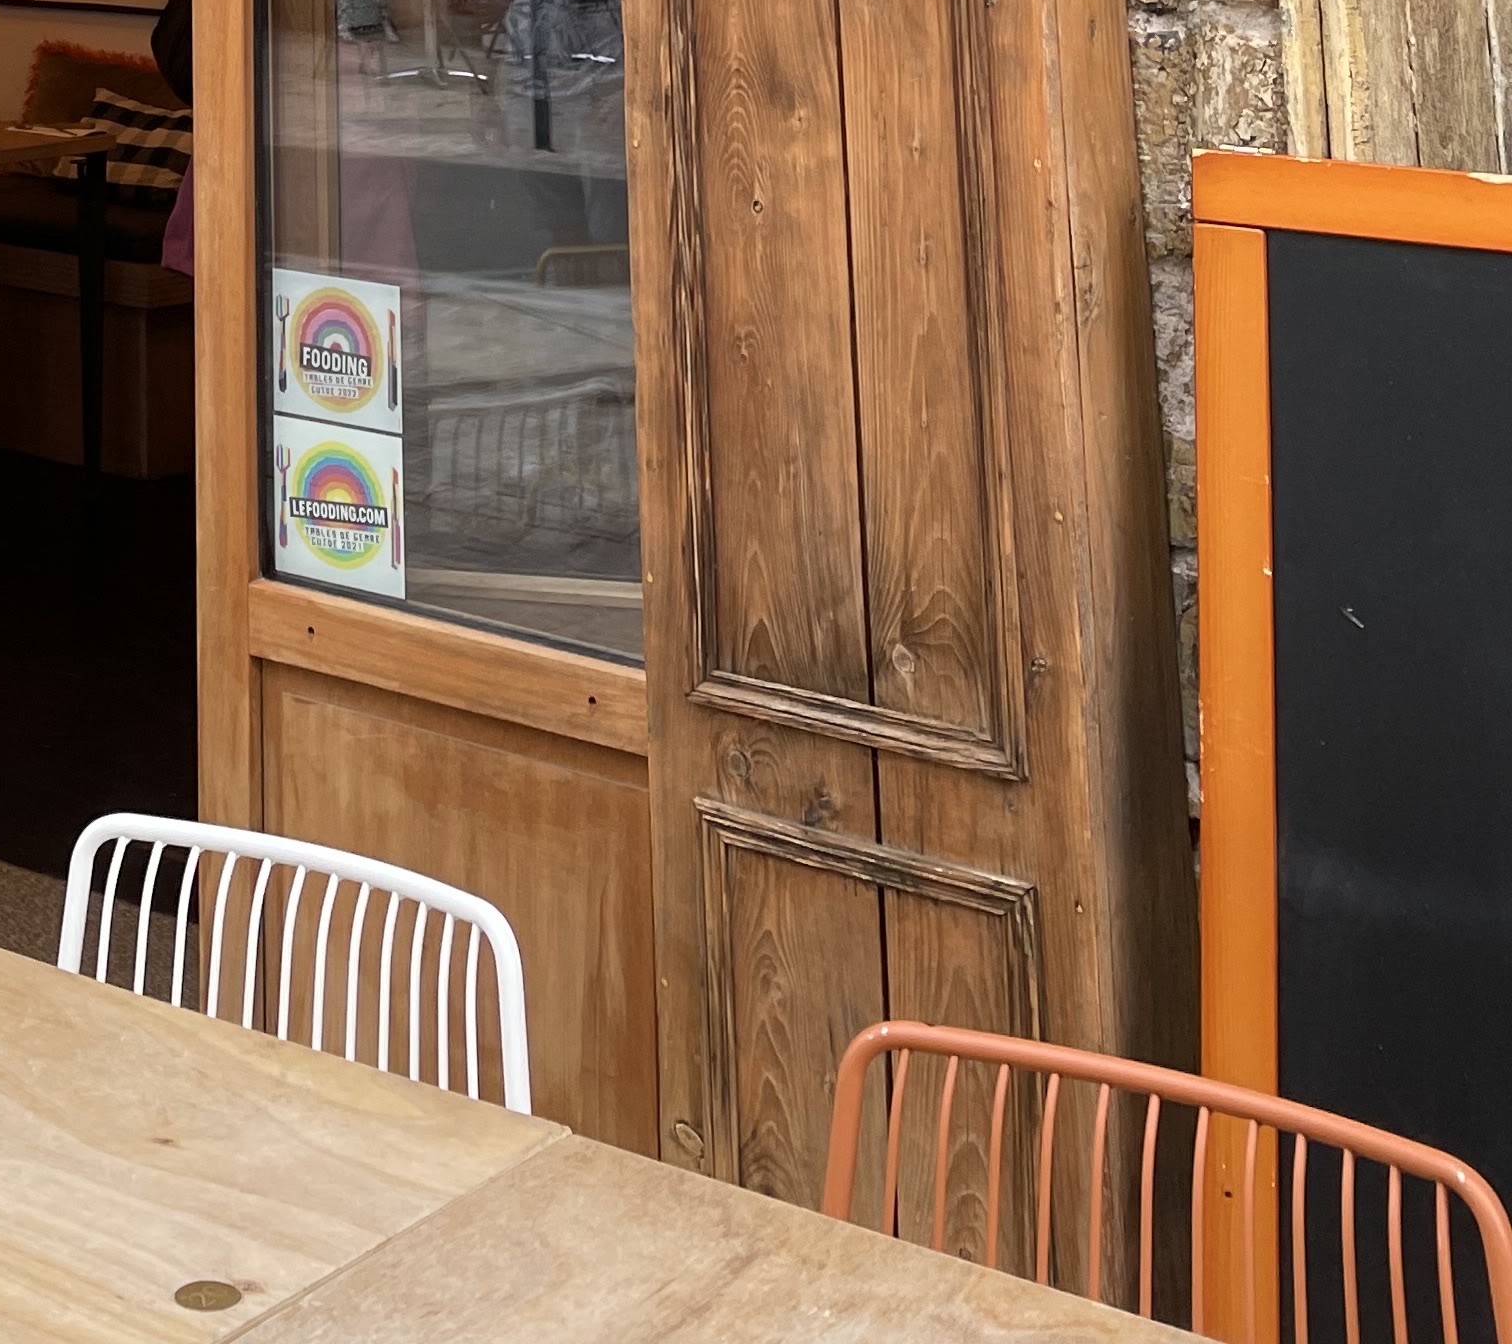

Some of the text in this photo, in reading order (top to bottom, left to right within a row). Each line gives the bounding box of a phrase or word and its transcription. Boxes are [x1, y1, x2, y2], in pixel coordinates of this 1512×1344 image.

[303, 347, 368, 376] FOODING
[304, 373, 333, 384] TABLES
[336, 376, 345, 384] DE
[311, 385, 334, 396] GUIDE
[292, 499, 386, 527] LEFOODING.COM
[305, 526, 337, 538] TABLES
[340, 531, 349, 540] DE
[311, 537, 362, 552] GUIDE 2021
